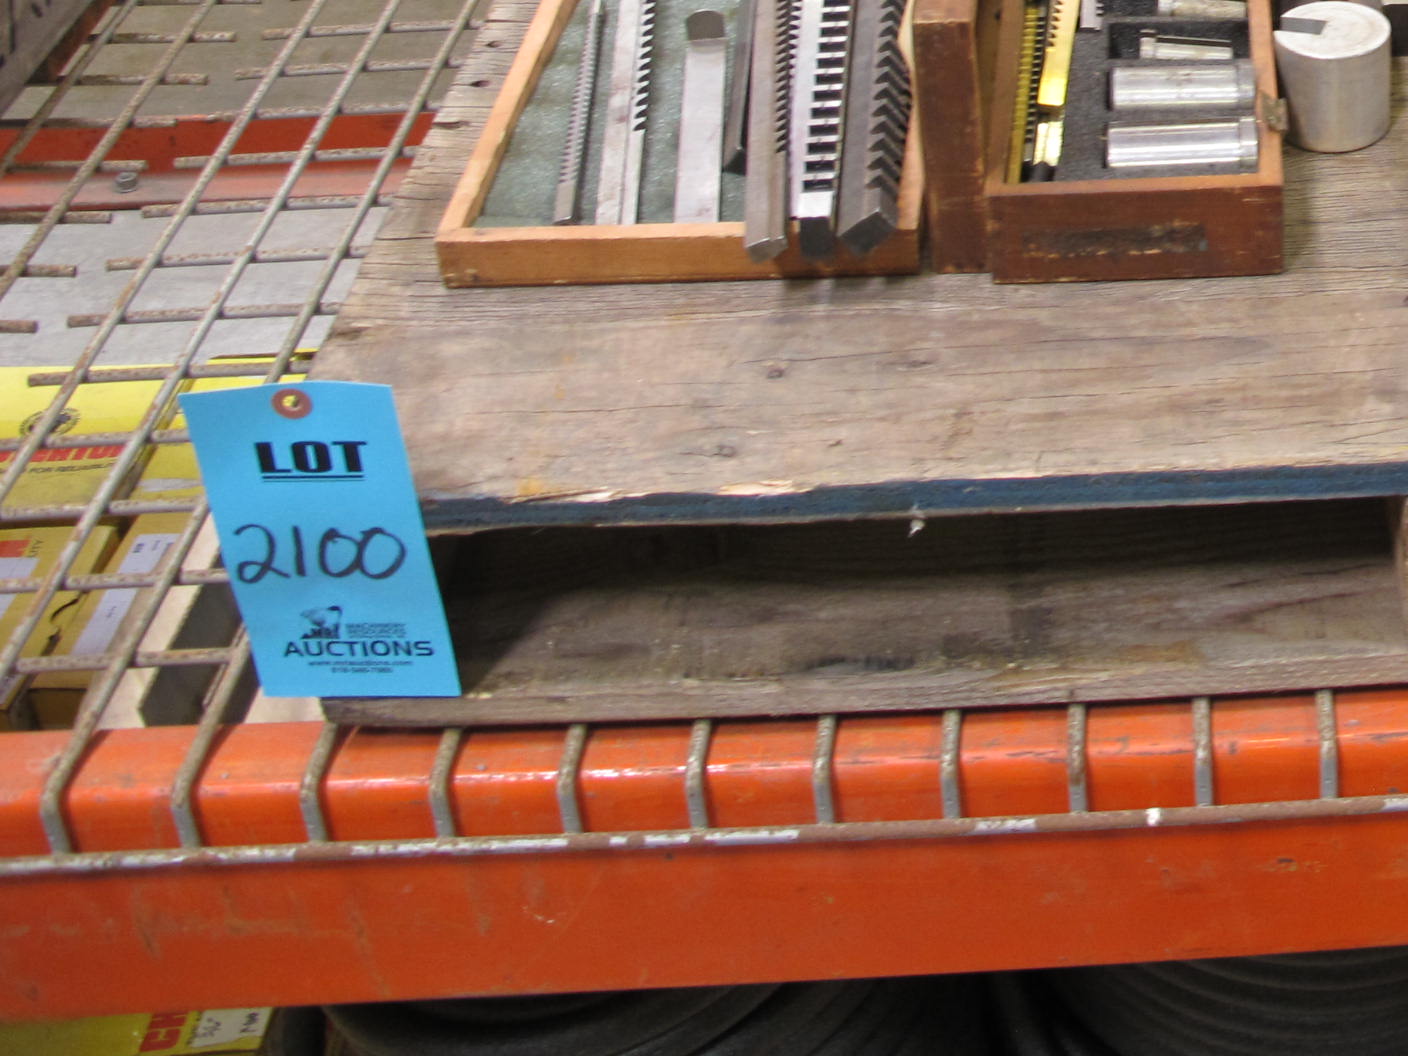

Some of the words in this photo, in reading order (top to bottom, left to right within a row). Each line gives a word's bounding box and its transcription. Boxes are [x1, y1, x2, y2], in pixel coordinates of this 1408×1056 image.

[254, 441, 367, 474] LOT
[233, 524, 406, 584] 2100
[283, 640, 435, 657] AUCTIONS
